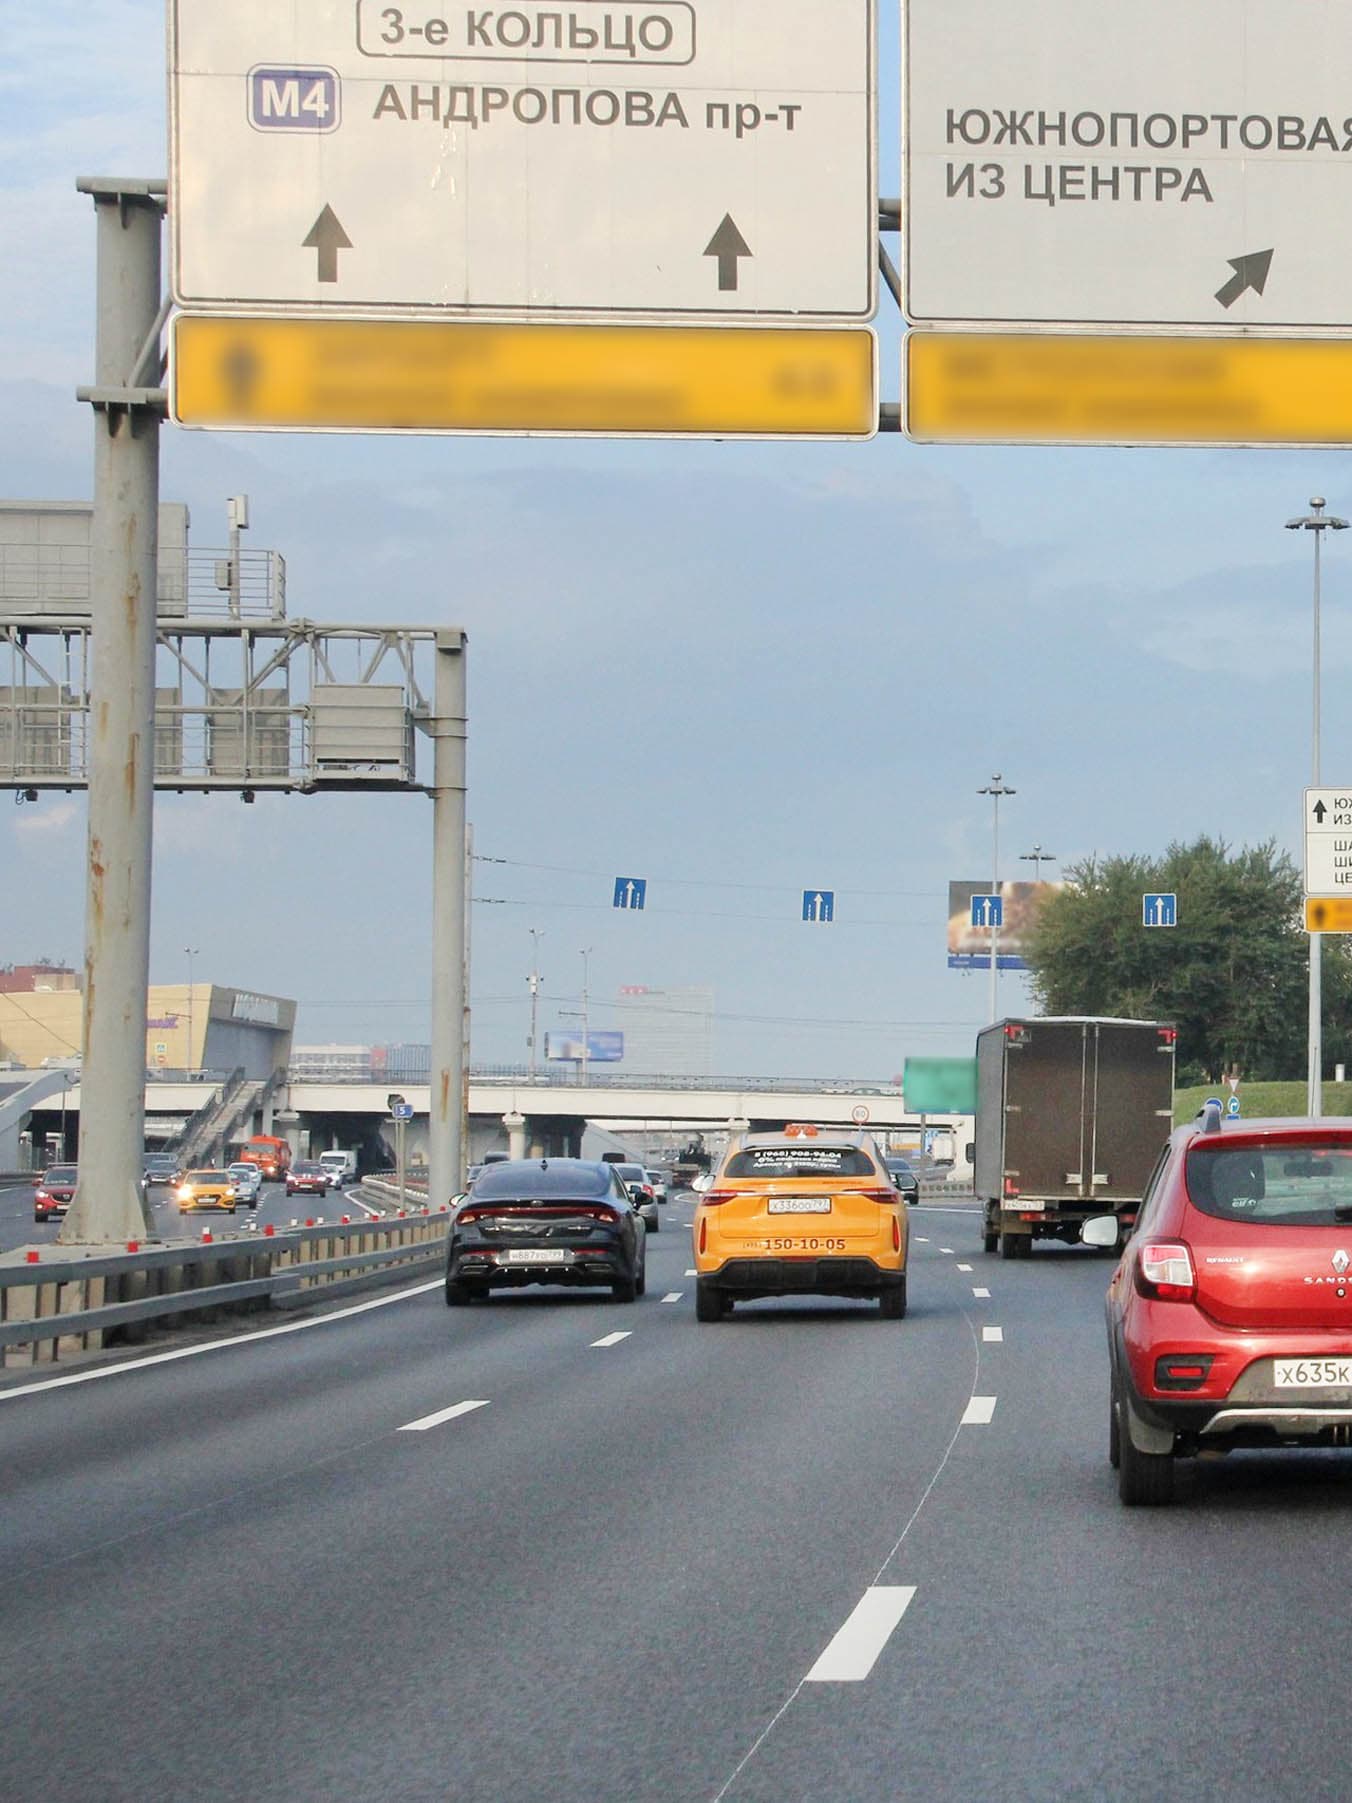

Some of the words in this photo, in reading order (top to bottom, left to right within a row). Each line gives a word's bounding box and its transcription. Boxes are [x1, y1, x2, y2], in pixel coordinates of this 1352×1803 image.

[381, 7, 448, 46] 3-е
[466, 10, 673, 56] КОЛЬЦО
[261, 79, 329, 119] М4
[373, 84, 689, 129] АНДРОПОВА
[706, 102, 802, 139] пр-т
[946, 162, 1006, 199] ИЗ
[1024, 164, 1214, 207] ЦЕНТРА
[1334, 813, 1352, 825] ИЗ
[765, 1239, 846, 1250] 150-10-05
